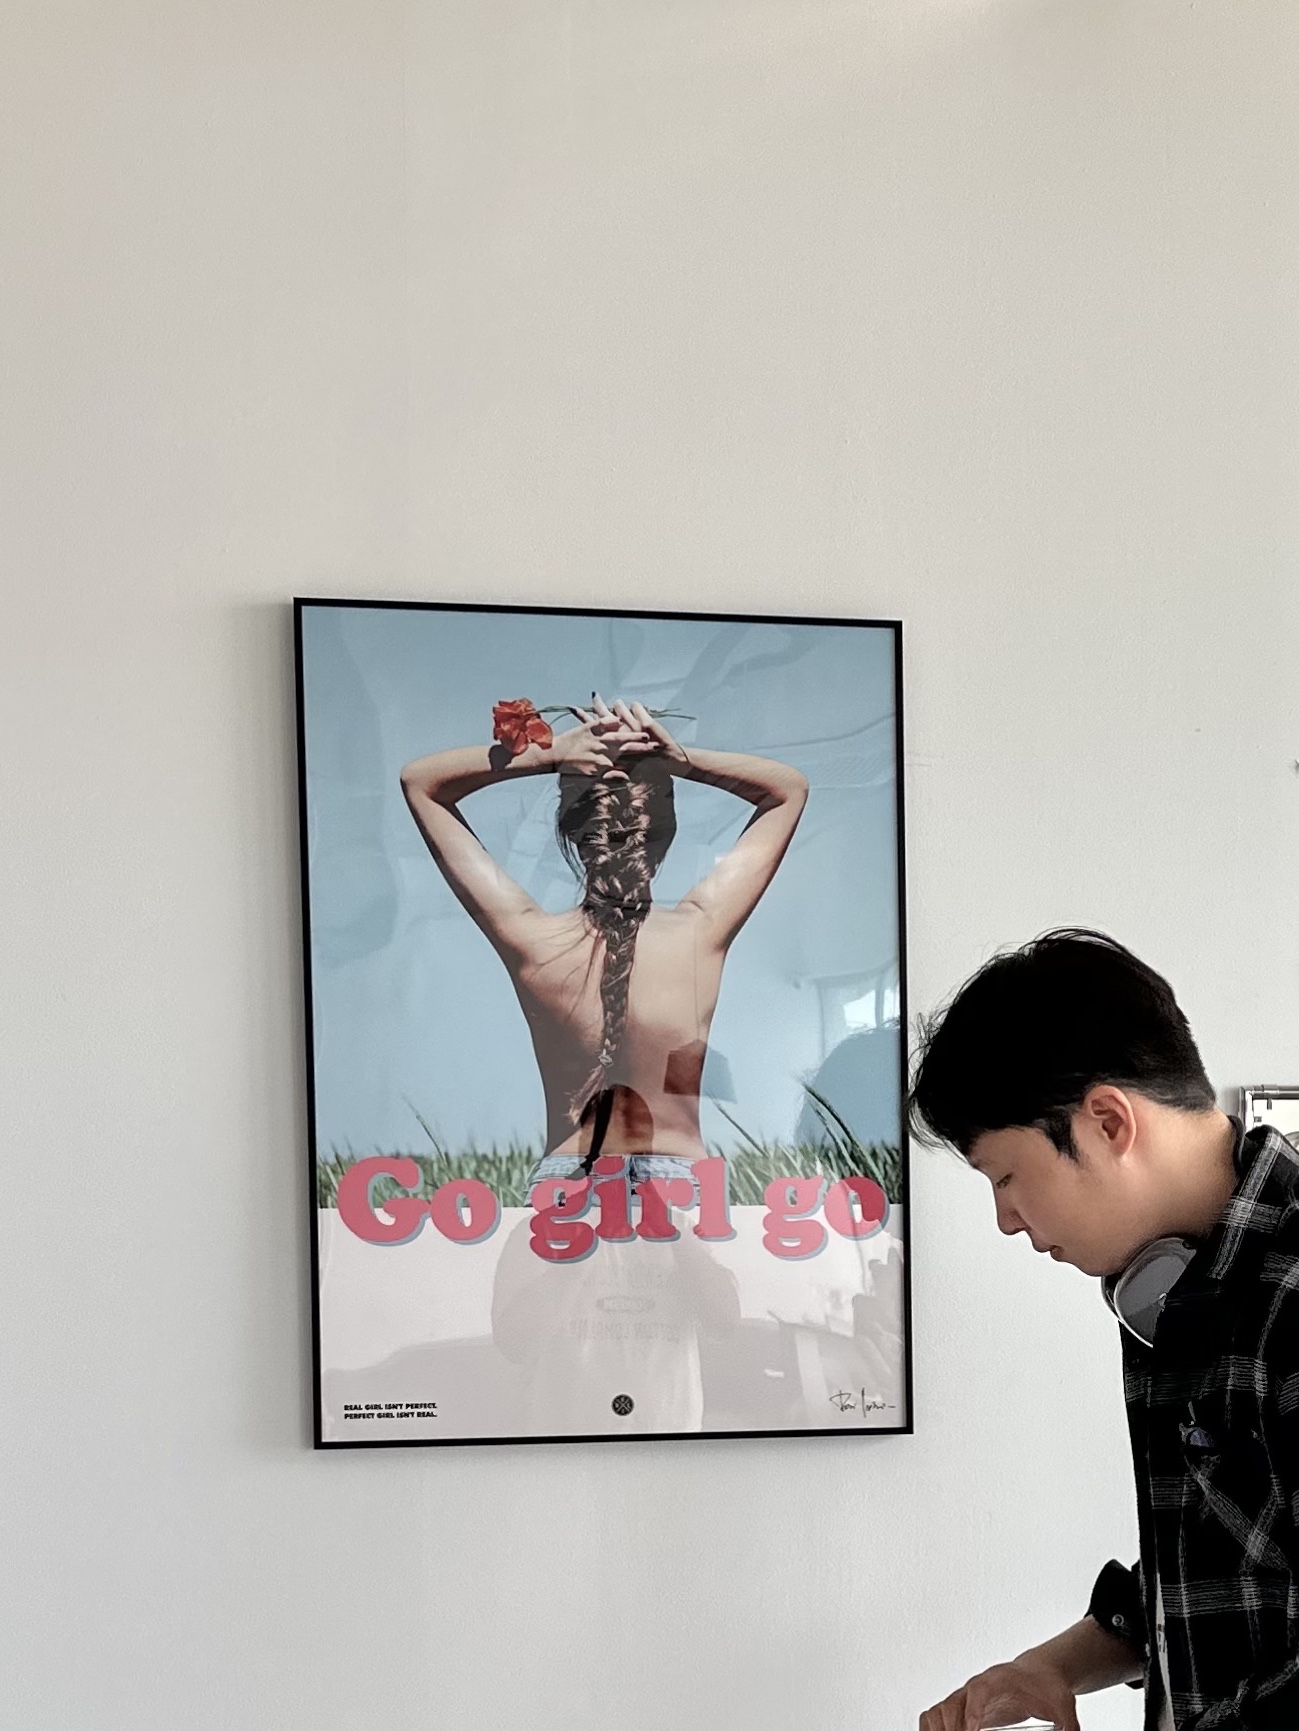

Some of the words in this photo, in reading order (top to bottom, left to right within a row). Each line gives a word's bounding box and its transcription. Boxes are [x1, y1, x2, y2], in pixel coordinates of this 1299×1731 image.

[337, 1156, 502, 1247] Go
[529, 1156, 738, 1264] girl
[762, 1175, 890, 1261] go
